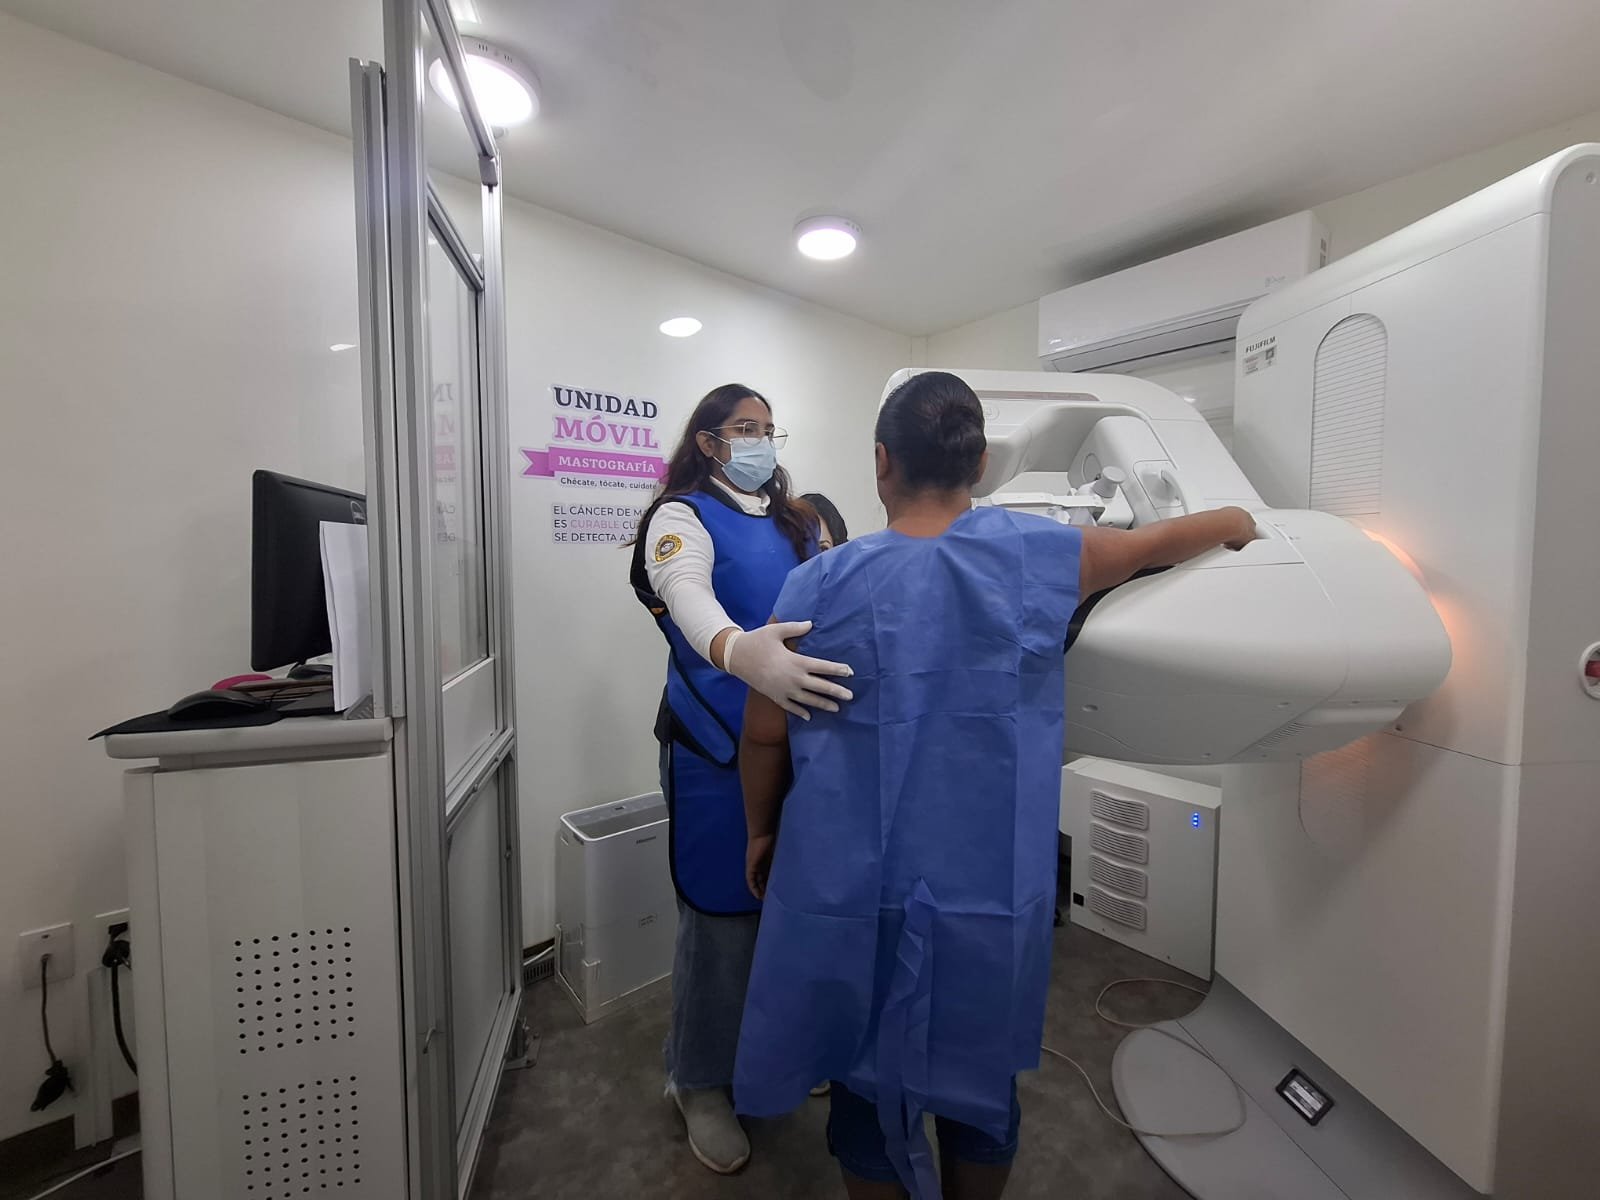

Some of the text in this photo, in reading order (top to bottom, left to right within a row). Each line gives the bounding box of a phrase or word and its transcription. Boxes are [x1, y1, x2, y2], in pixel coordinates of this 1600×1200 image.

[554, 387, 658, 418] UNIDAD
[554, 415, 658, 448] MÓVIL
[559, 456, 656, 473] MASTOGRAFÍA
[553, 506, 567, 514] EL
[569, 504, 614, 516] CÁNCER
[617, 508, 631, 516] DE
[554, 520, 567, 528] ES
[570, 520, 619, 528] CURABLE
[554, 533, 567, 541] SE
[571, 533, 617, 541] DETECTA
[619, 533, 627, 541] A
